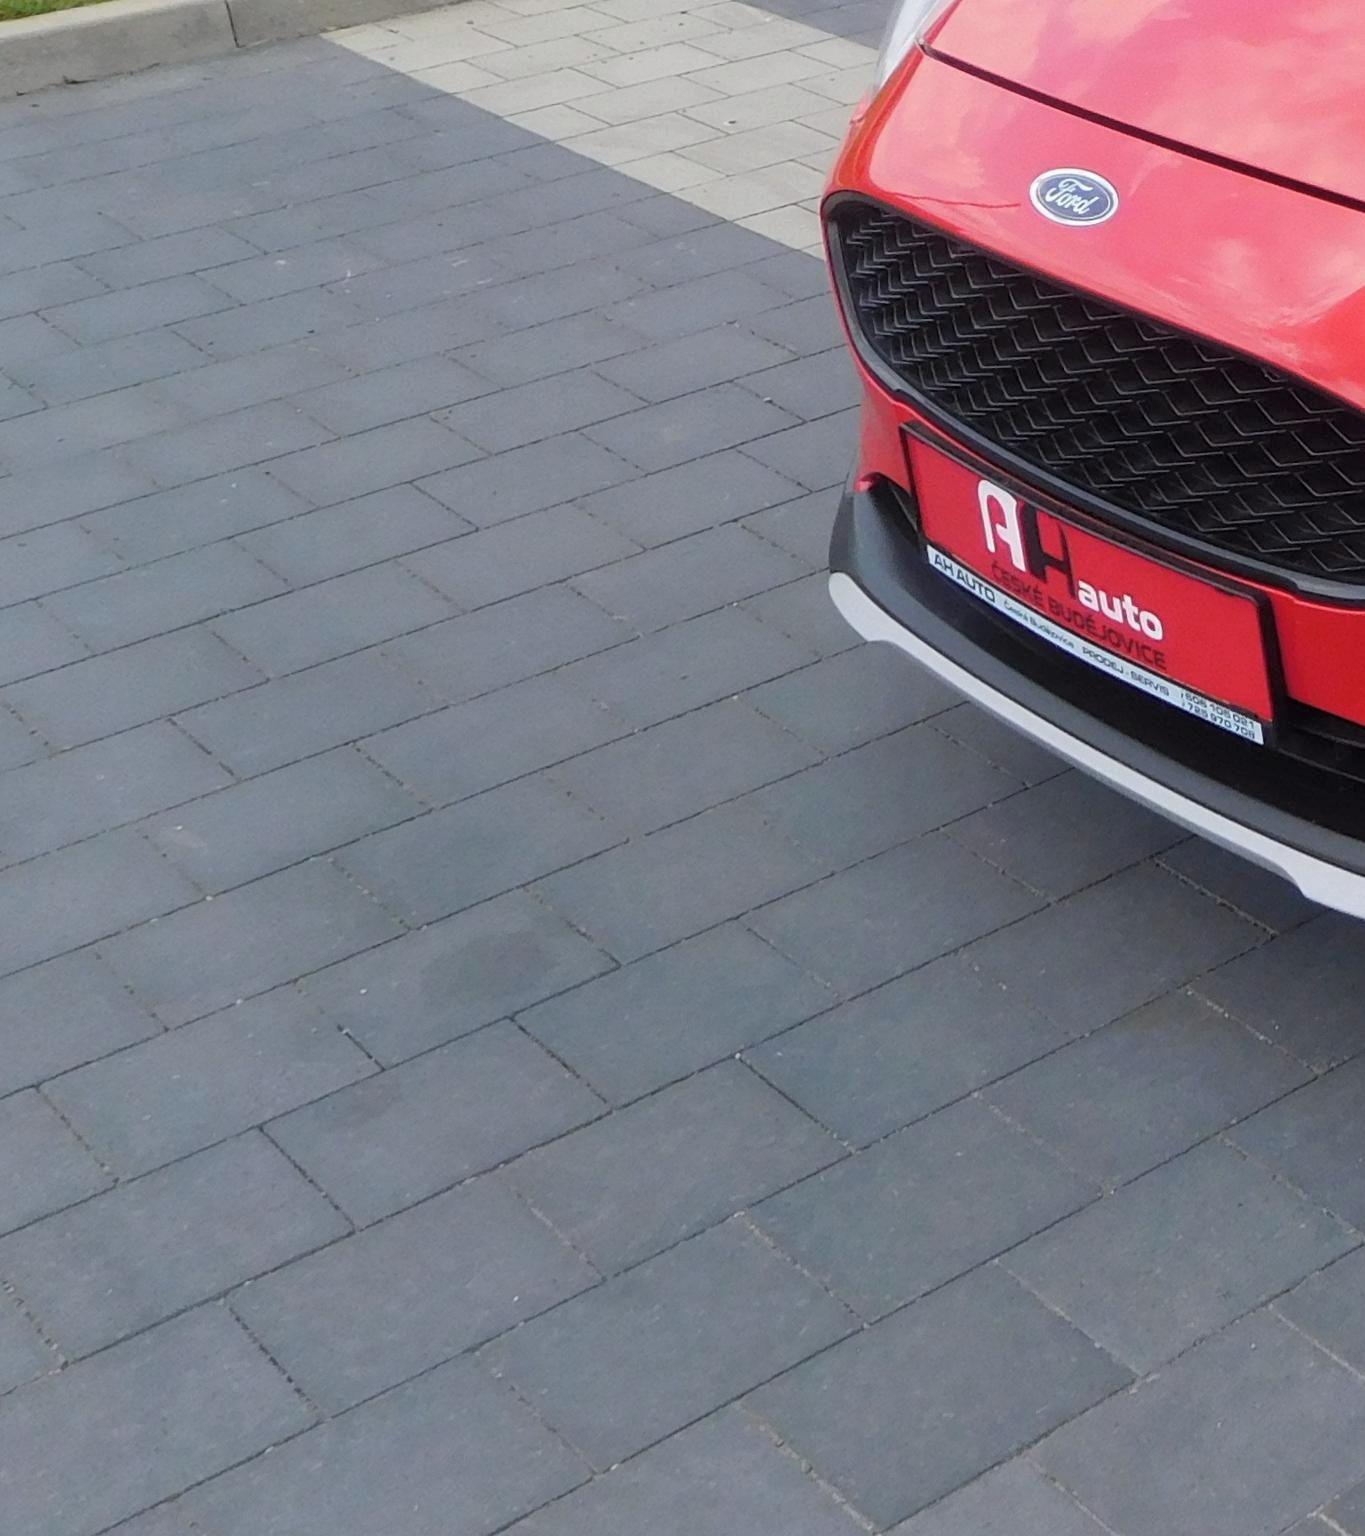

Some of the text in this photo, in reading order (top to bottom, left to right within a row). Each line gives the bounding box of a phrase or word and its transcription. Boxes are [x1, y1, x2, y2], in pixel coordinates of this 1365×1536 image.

[1045, 178, 1100, 215] Ford
[934, 554, 955, 576] AH
[956, 567, 996, 603] AUTO
[1078, 579, 1163, 641] auto
